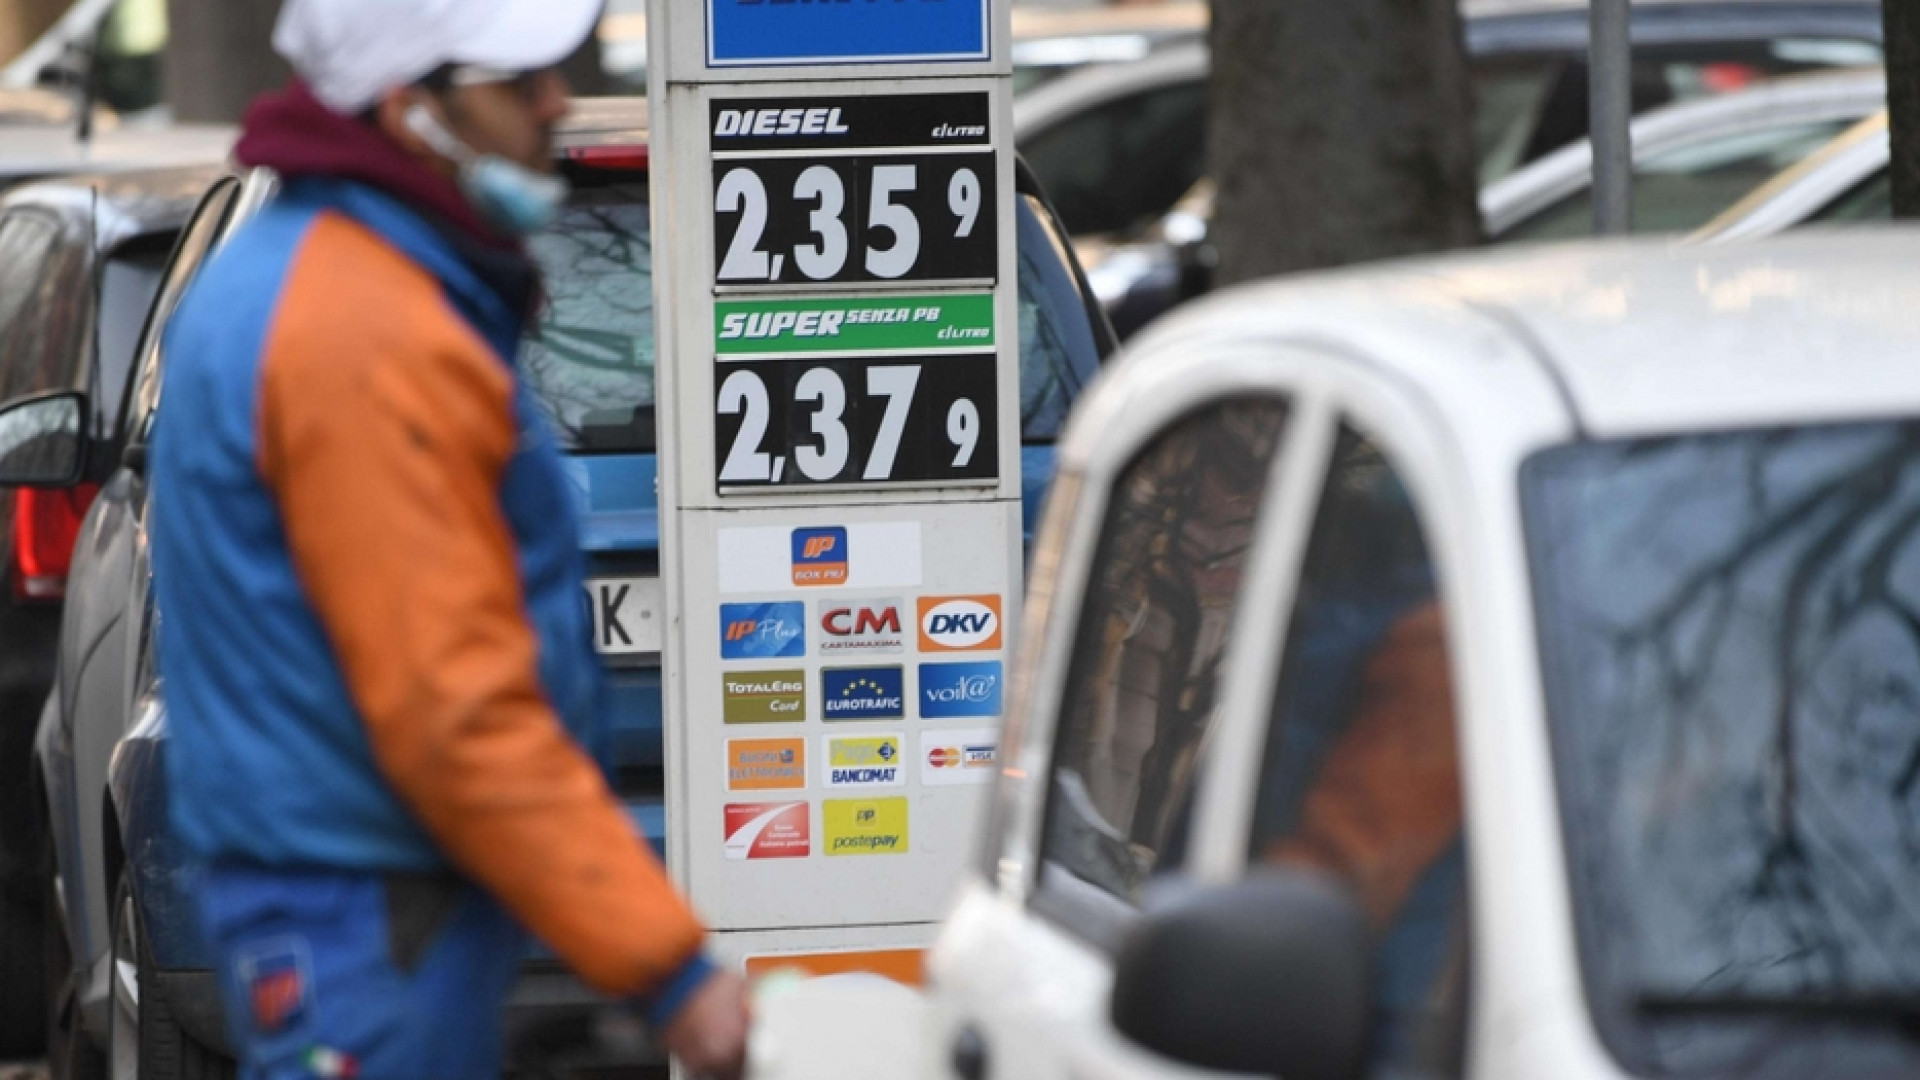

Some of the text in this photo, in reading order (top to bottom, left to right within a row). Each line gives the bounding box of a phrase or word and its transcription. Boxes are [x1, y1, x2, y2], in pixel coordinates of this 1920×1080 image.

[714, 107, 849, 136] DIESEL
[718, 307, 941, 338] SUPER SENZA PB
[803, 536, 836, 558] IP
[821, 606, 902, 636] CM
[928, 612, 992, 634] DKV
[769, 699, 799, 712] Card
[826, 697, 900, 711] EUROTRAFIC
[831, 768, 896, 783] BANCOMAT
[832, 834, 899, 850] postepay
